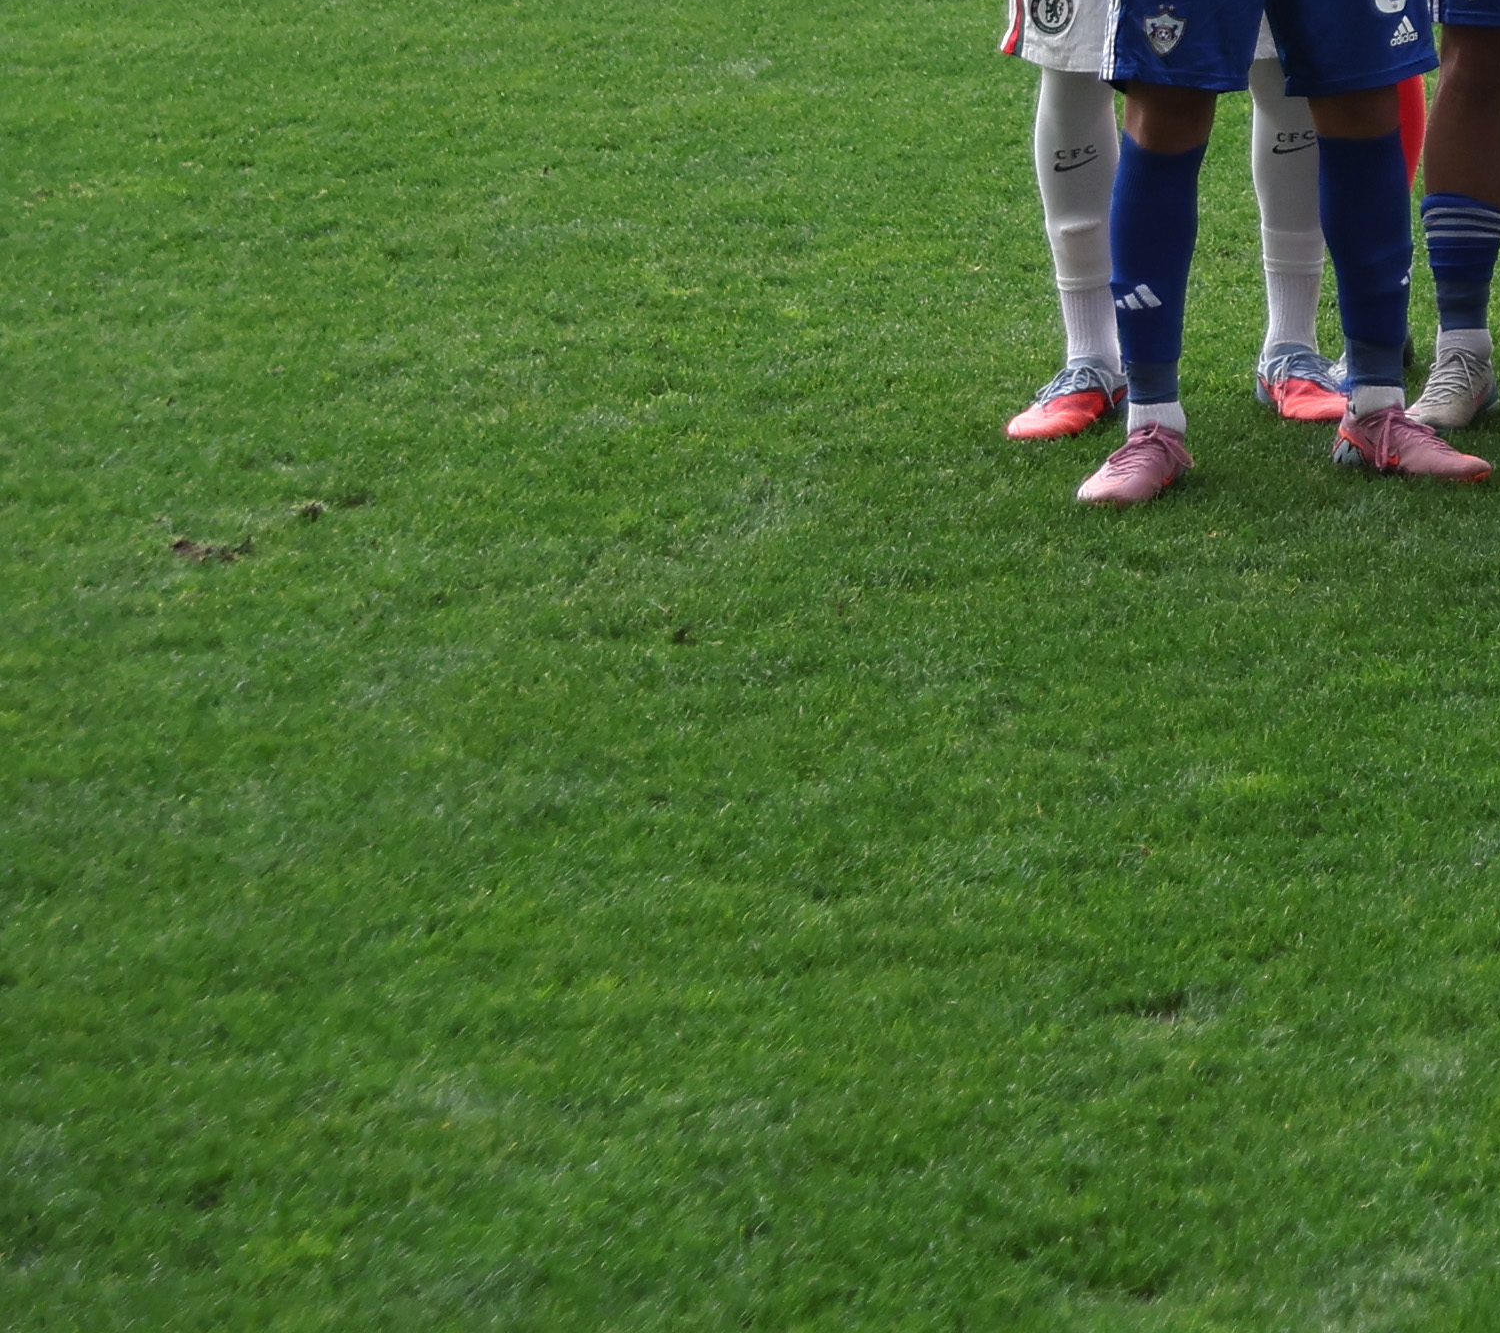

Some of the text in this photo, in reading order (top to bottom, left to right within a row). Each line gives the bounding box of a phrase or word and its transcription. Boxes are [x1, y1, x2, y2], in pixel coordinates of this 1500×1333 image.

[1390, 30, 1419, 46] adidas
[1276, 130, 1316, 143] CFC
[1053, 144, 1098, 160] CFC
